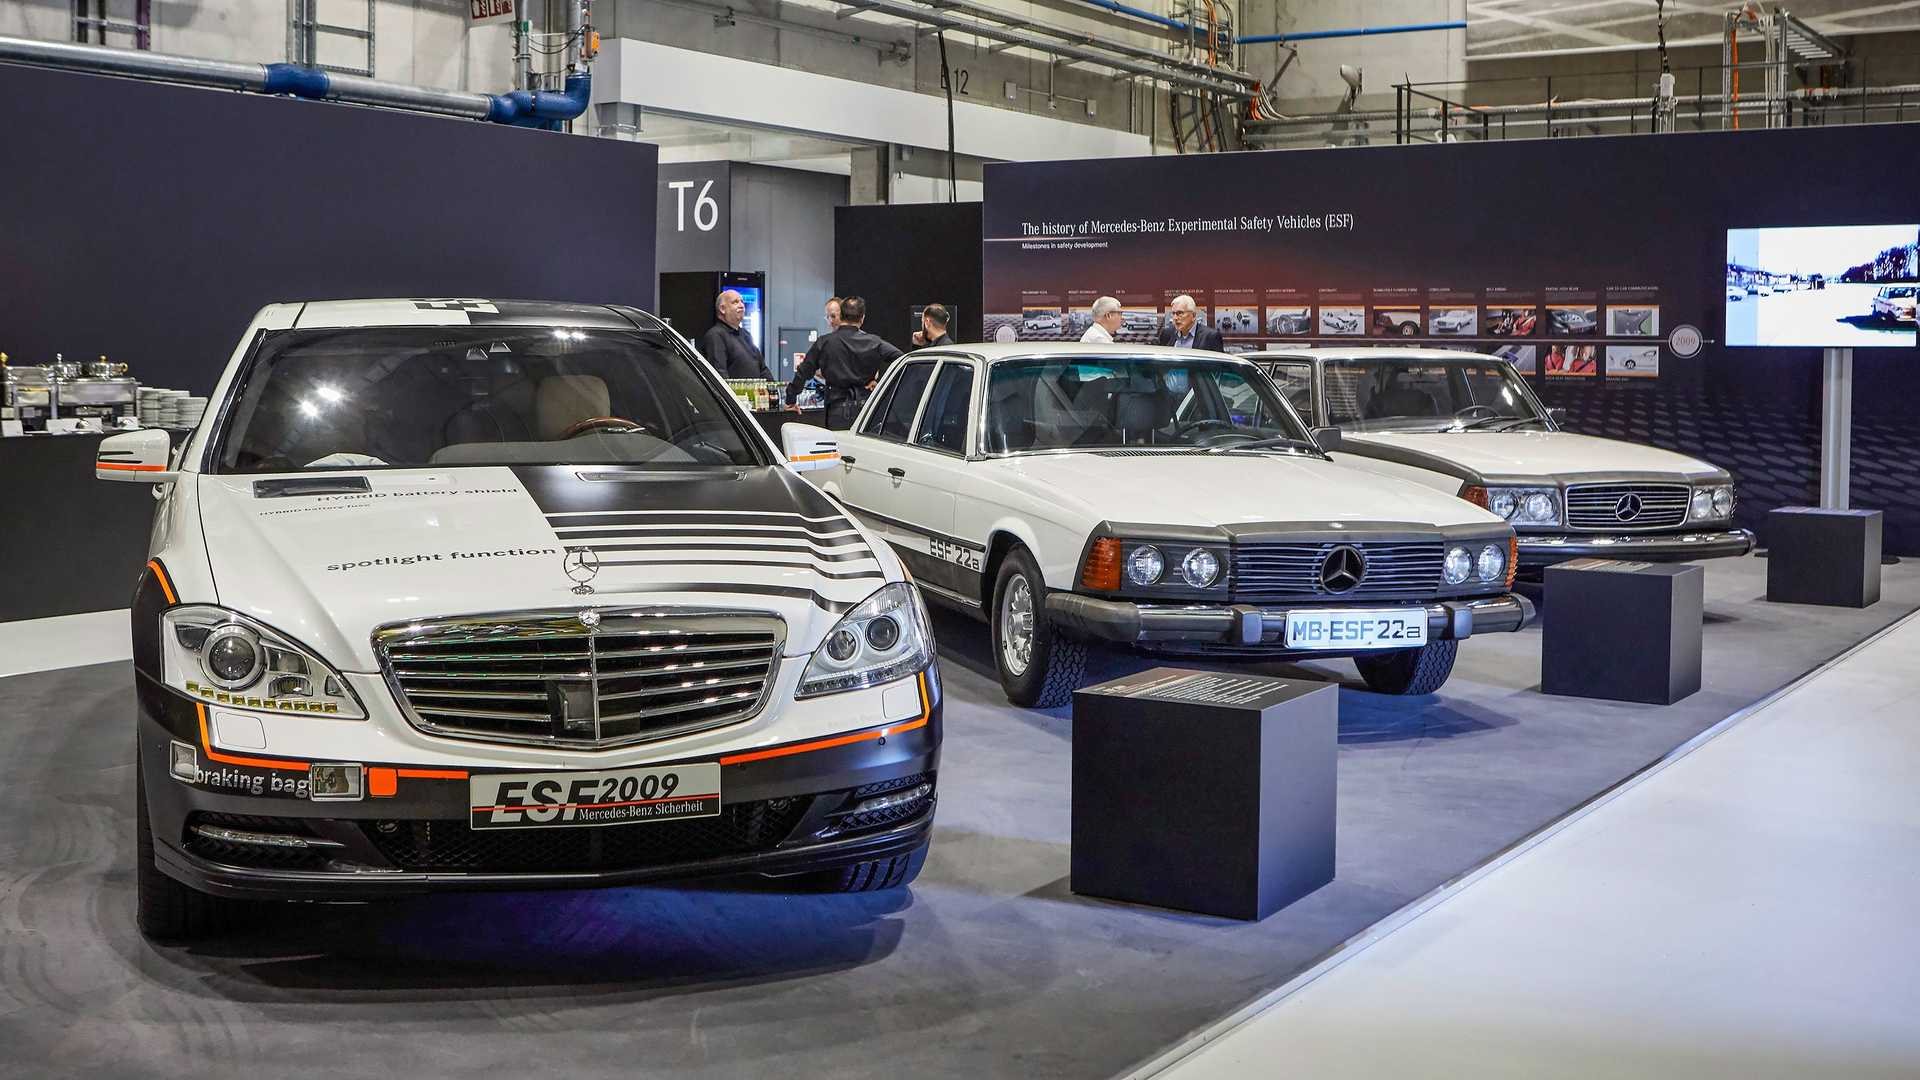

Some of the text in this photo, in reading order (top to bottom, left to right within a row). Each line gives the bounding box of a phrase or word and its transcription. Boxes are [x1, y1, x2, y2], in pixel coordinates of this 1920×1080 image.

[668, 180, 719, 231] T6
[1021, 213, 1354, 237] The history of Mercedes-Benz Experimental Safety Vehicles (ESF)
[1057, 241, 1073, 250] safety
[1074, 241, 1108, 249] development
[317, 487, 518, 502] HYBRID battery shield
[327, 548, 556, 572] spotlight function
[929, 538, 952, 561] ESF
[1292, 619, 1421, 641] MB-ESF 22a
[193, 764, 309, 799] braking bag
[578, 801, 703, 821] Mercedes-Benz Sicherheit
